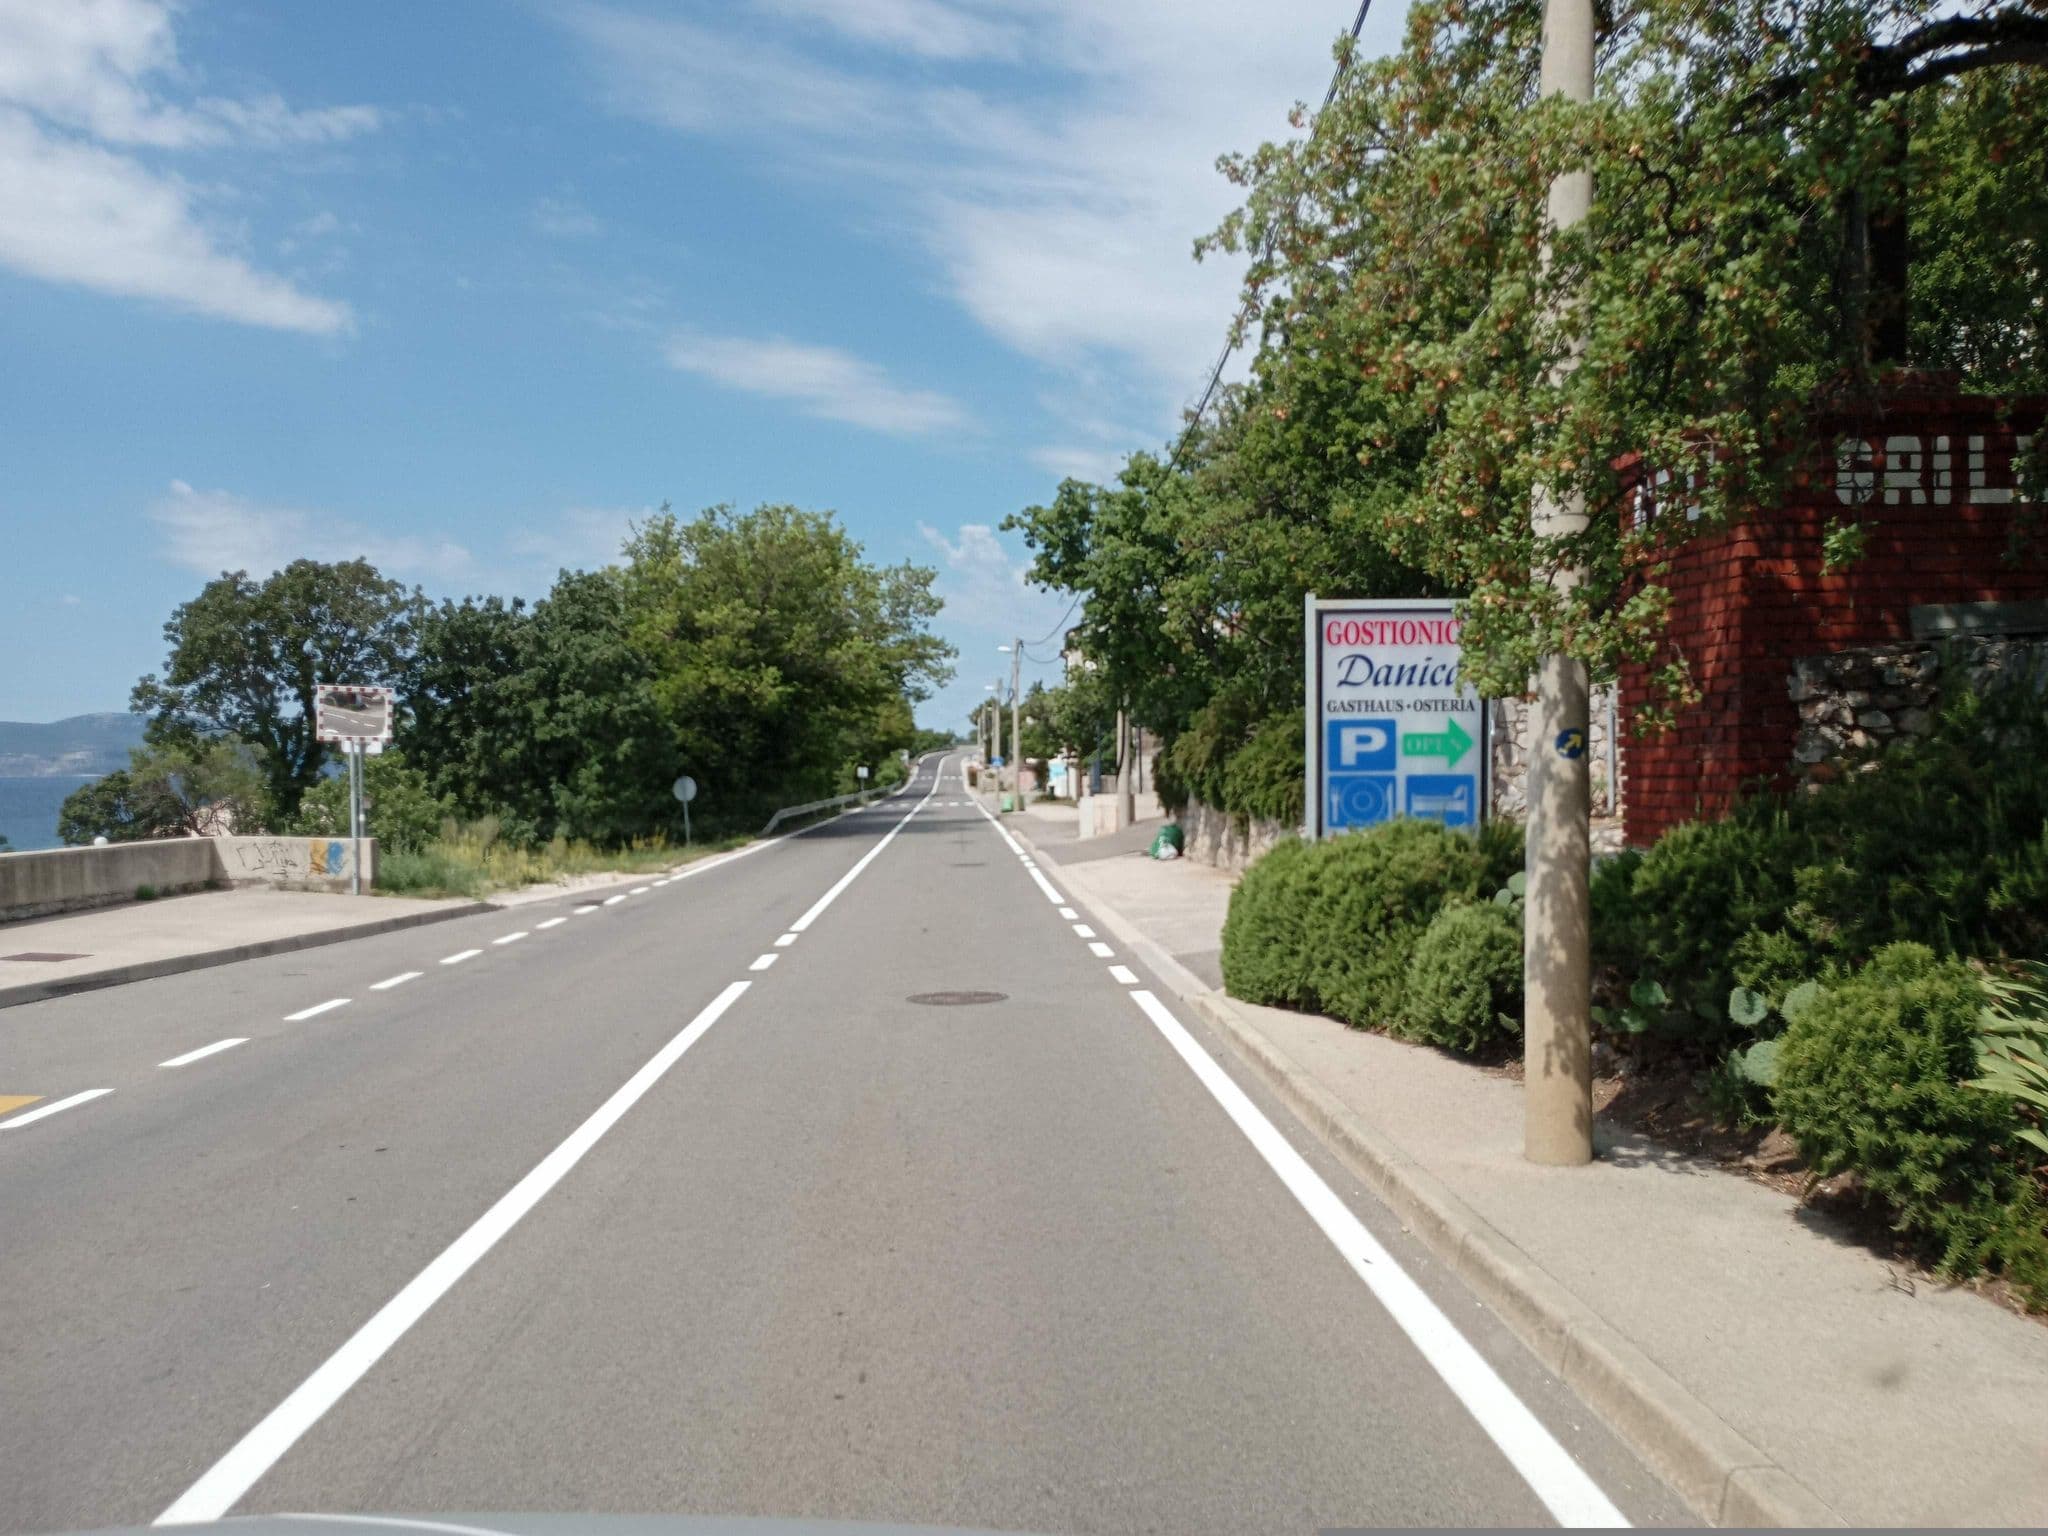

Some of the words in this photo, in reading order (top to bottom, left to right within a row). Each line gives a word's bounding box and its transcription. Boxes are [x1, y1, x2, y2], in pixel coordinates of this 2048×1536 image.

[1326, 620, 1466, 646] GOSTIONIC
[1326, 699, 1404, 713] GASTHAUS
[1412, 698, 1476, 712] OSTERIA
[1340, 727, 1388, 766] P
